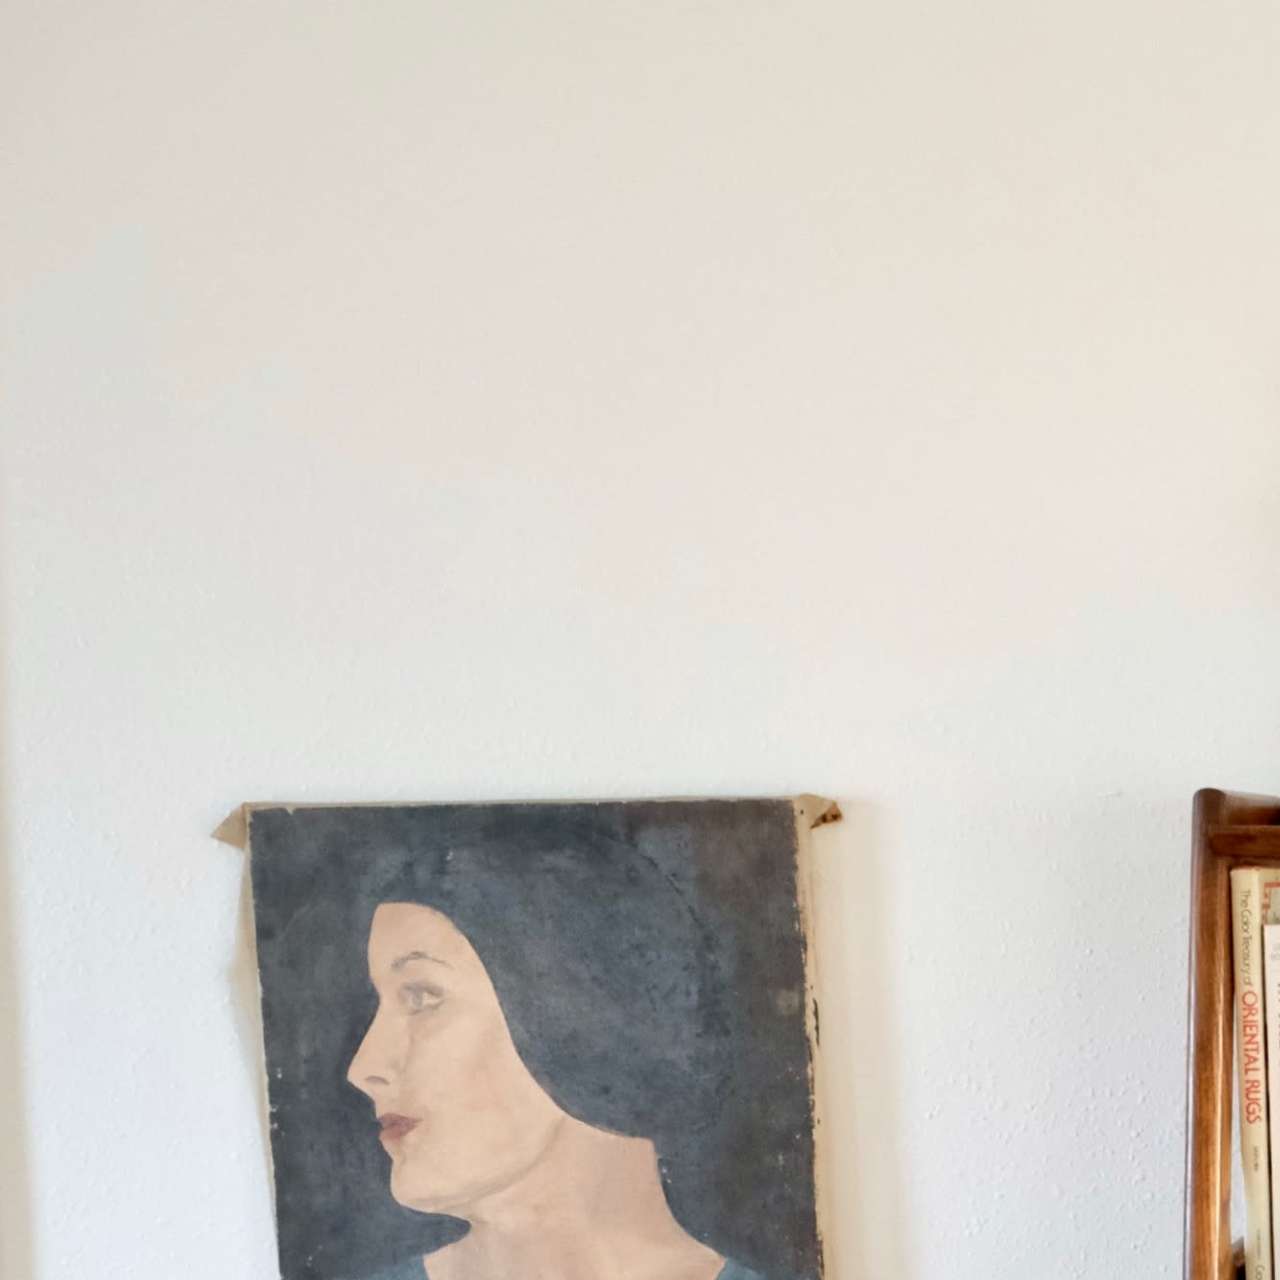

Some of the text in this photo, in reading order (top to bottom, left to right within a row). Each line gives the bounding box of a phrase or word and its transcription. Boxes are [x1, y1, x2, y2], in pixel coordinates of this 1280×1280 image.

[1239, 889, 1252, 909] The
[1240, 909, 1253, 935] Color
[1242, 990, 1260, 1075] ORIENTAL
[1246, 1078, 1263, 1125] RUGS
